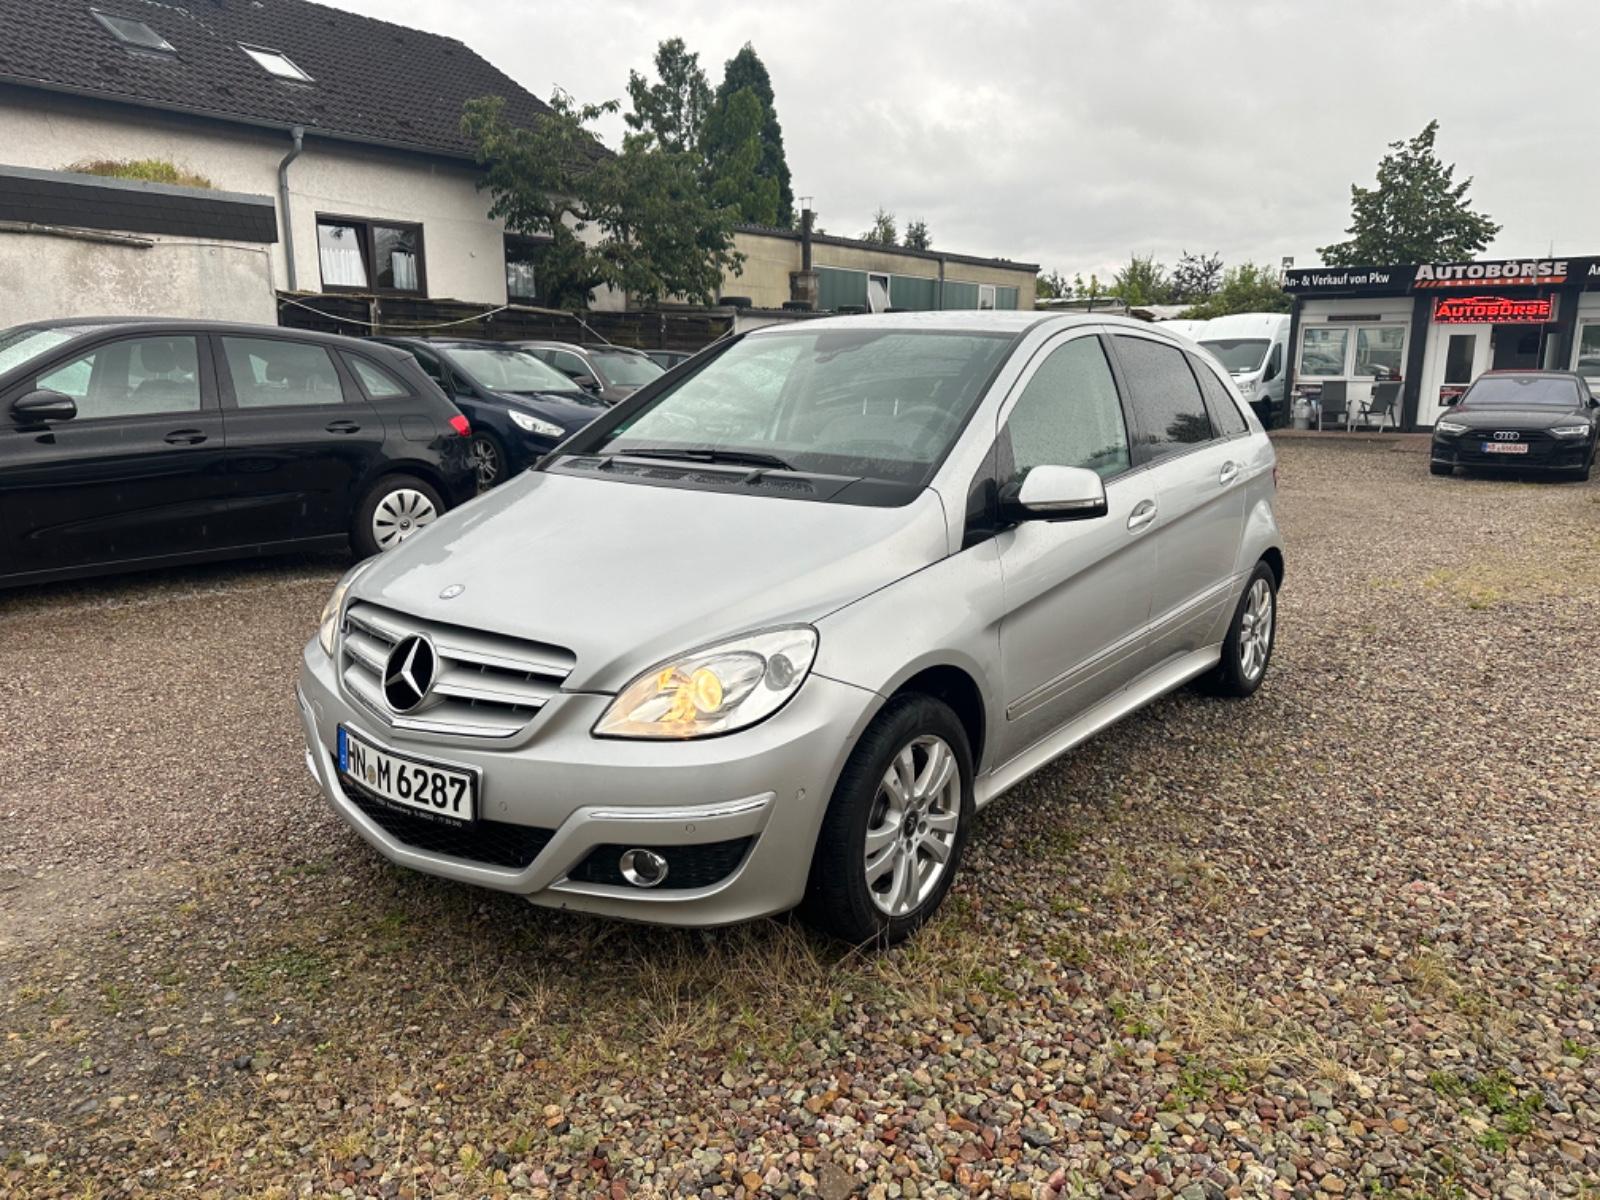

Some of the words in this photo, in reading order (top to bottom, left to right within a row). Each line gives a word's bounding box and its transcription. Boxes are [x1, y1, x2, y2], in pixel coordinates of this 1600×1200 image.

[1301, 274, 1310, 287] &
[1312, 272, 1348, 286] Verkauf
[1349, 274, 1367, 285] von
[1369, 271, 1390, 284] Pkw
[1415, 261, 1568, 280] AUTOBÖRSE
[1437, 302, 1549, 317] AUTOBÖRSE
[377, 755, 391, 793] M
[397, 764, 468, 812] 6287
